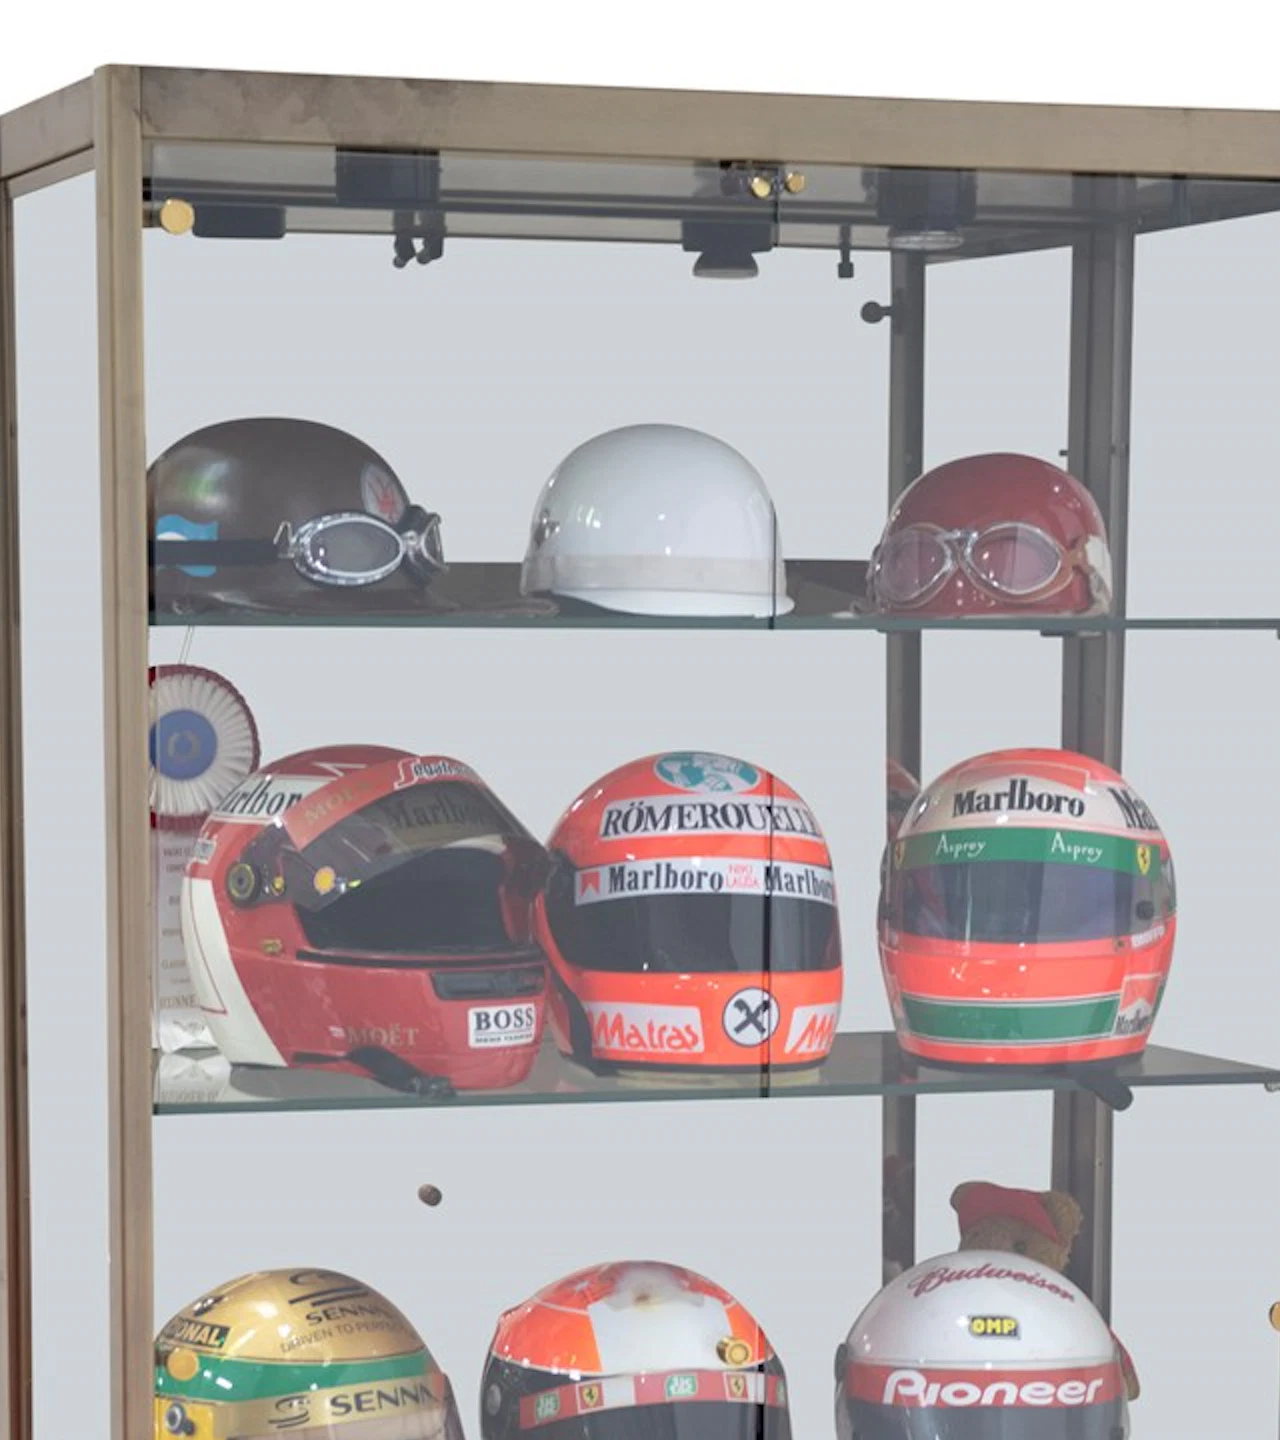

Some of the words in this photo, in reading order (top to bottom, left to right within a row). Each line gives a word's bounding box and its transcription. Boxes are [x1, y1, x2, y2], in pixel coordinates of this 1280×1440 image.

[952, 779, 1086, 818] Marlboro
[936, 832, 986, 858] Asprey
[1051, 831, 1104, 863] Asprey
[607, 859, 724, 894] Marlboro
[474, 1007, 534, 1031] BOSS
[907, 1263, 1075, 1303] Budweiser
[971, 1317, 1017, 1335] OMP
[883, 1369, 1104, 1408] Pioneer
